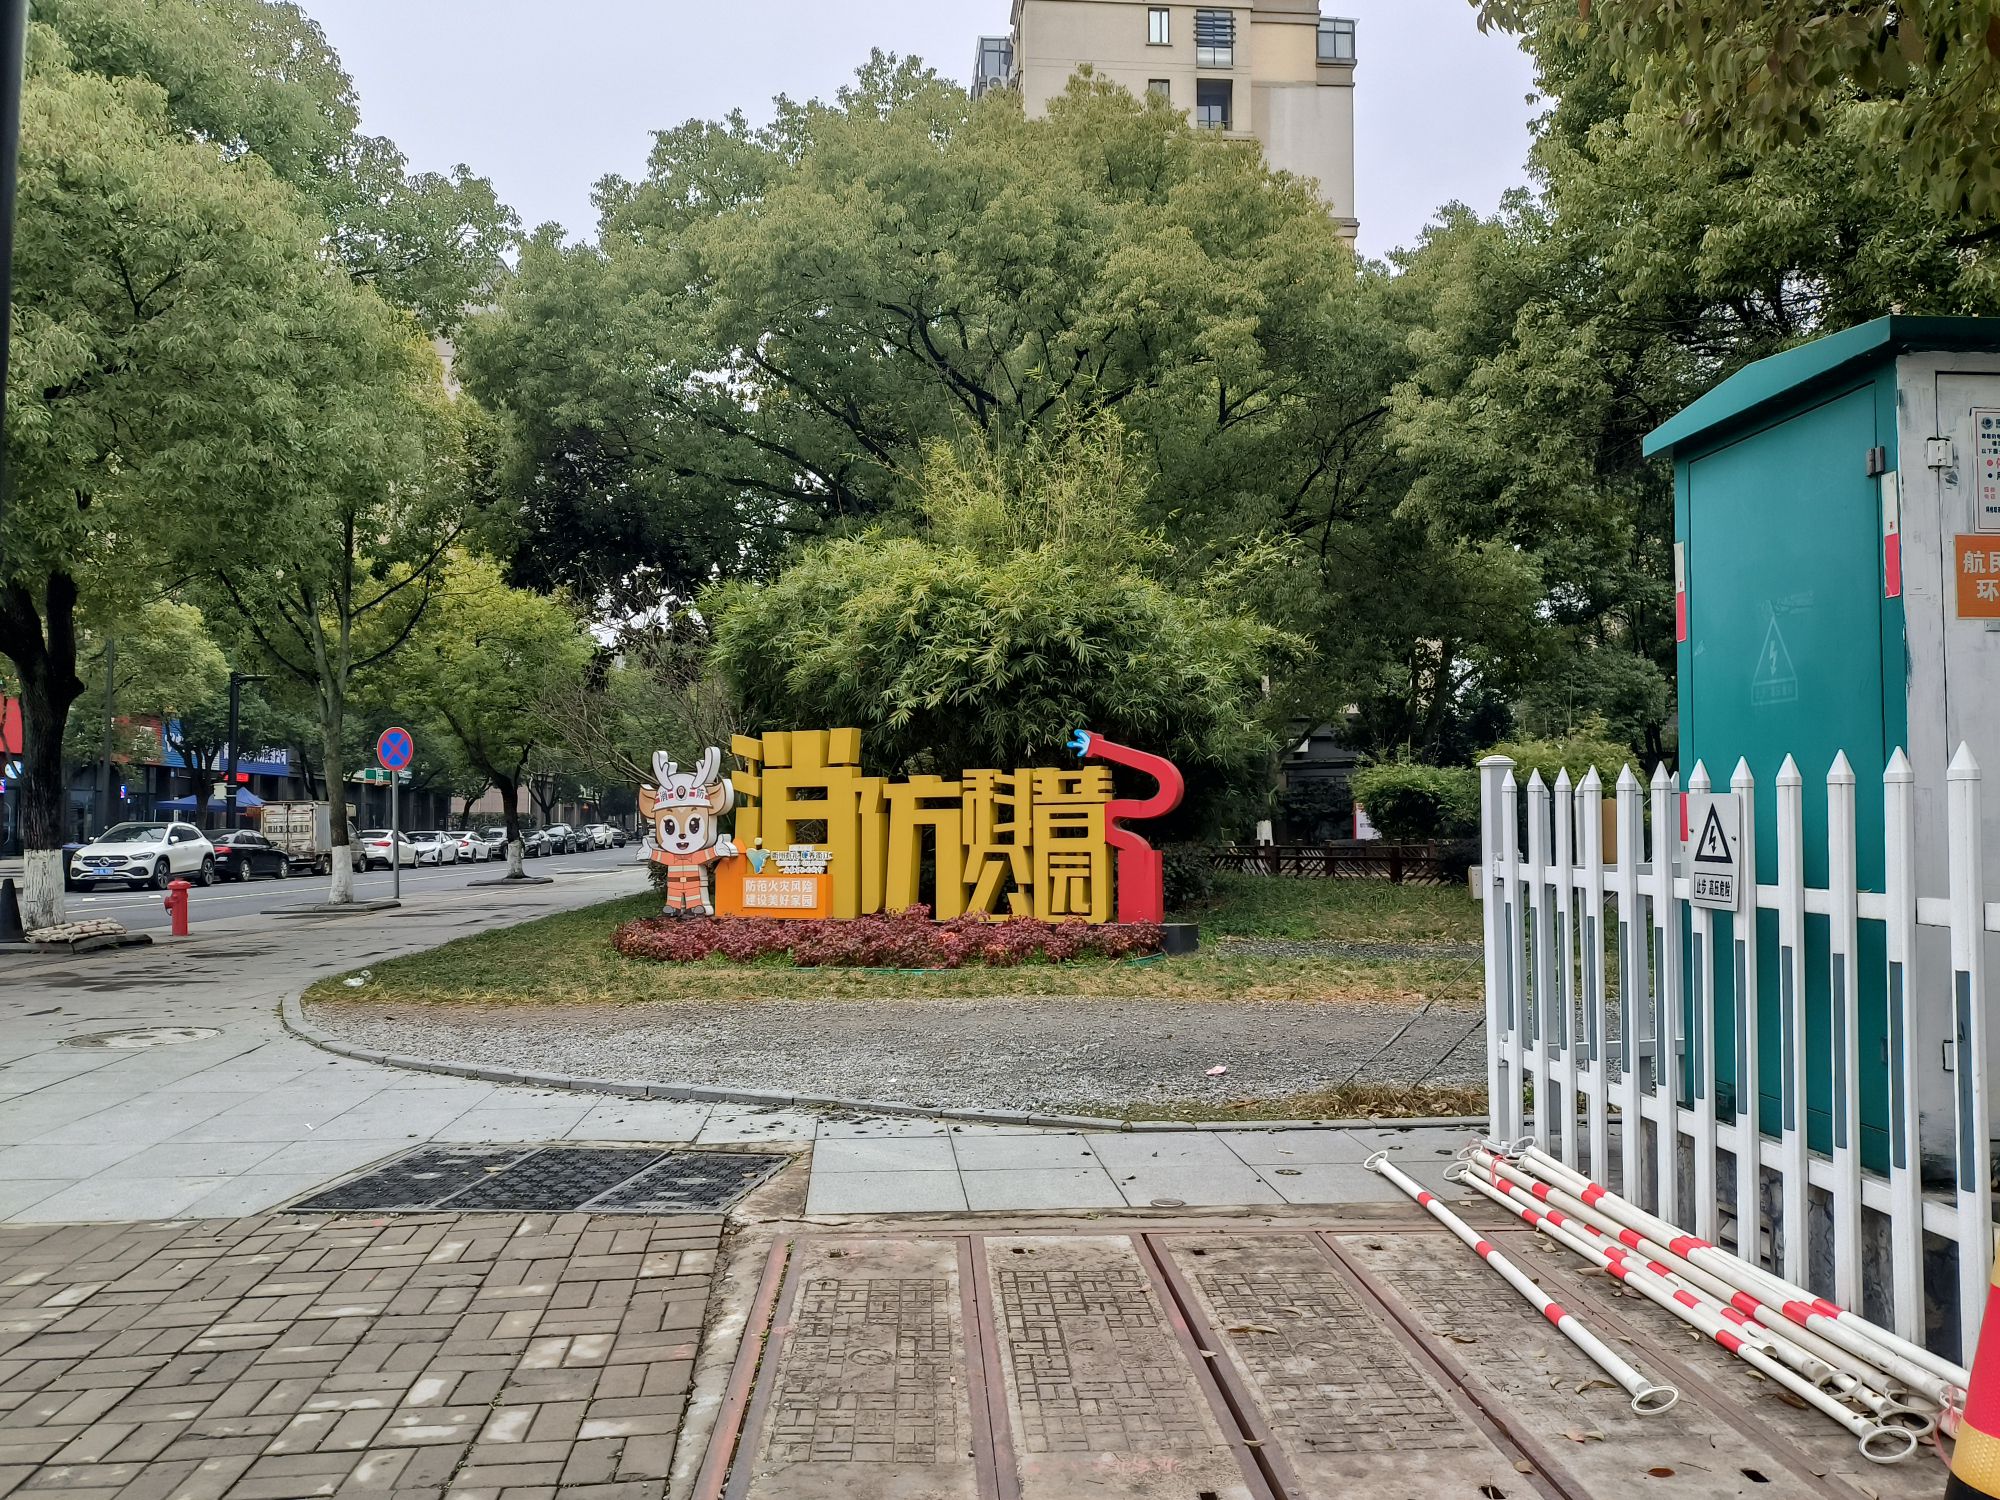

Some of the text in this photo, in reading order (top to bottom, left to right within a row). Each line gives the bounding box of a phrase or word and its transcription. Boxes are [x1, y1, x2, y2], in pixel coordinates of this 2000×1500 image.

[1976, 579, 2000, 602] 环
[745, 879, 813, 893] 防范火灾风险
[745, 894, 813, 907] 建设美好家园
